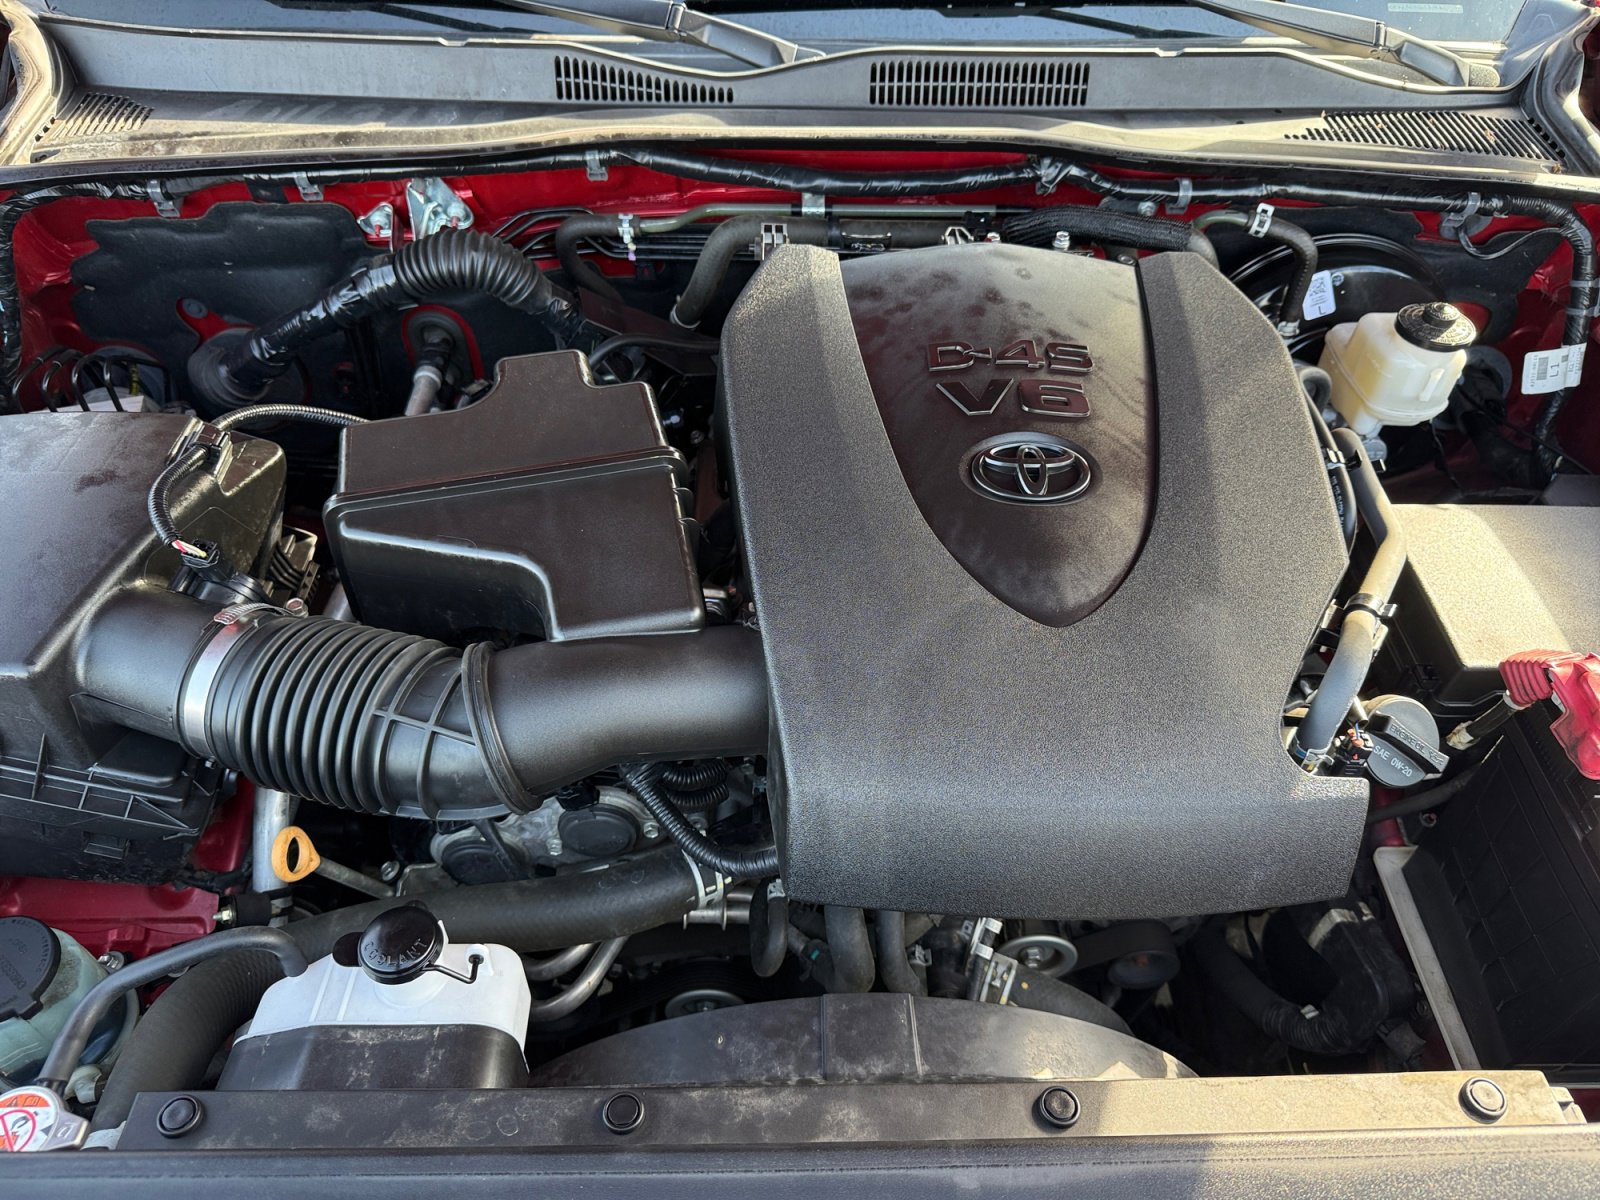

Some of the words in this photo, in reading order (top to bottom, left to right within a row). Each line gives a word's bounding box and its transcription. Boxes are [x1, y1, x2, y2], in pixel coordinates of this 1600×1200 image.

[928, 339, 1094, 373] D-4S
[935, 378, 1091, 418] V6
[1389, 723, 1418, 745] ENGINE
[1373, 745, 1390, 760] SAE
[1391, 757, 1413, 777] 0W-20
[363, 937, 428, 967] COOLANT
